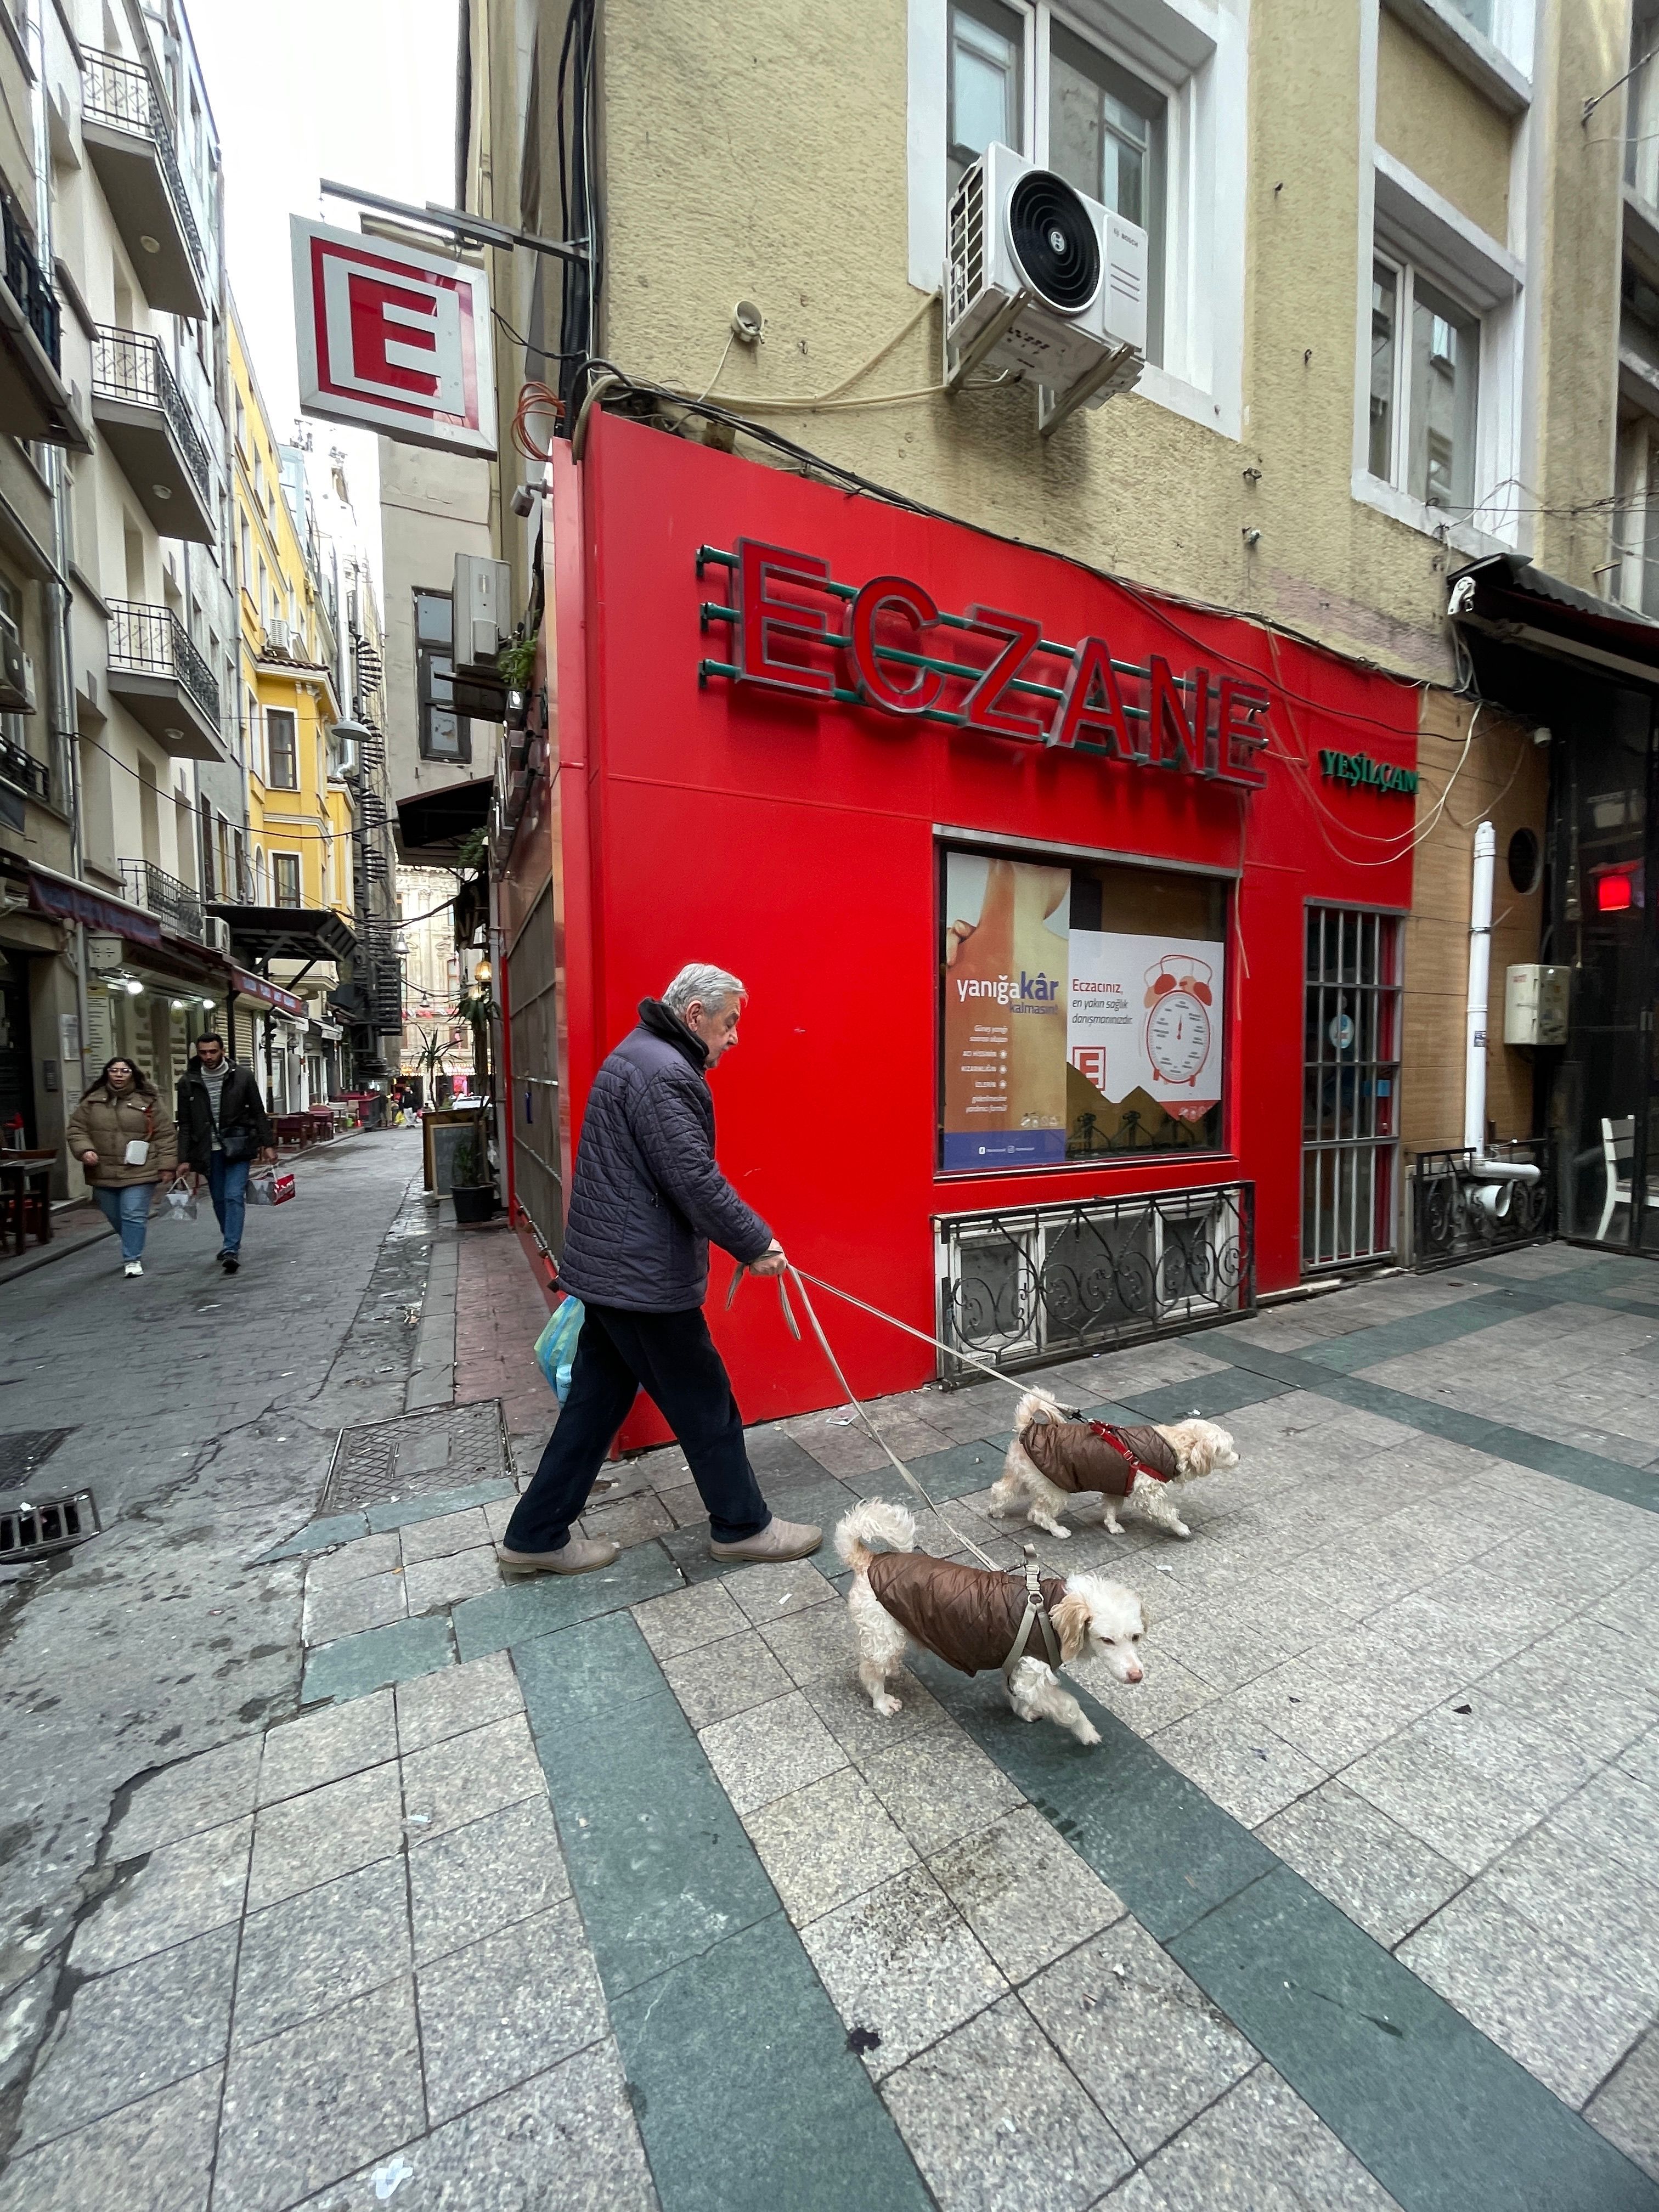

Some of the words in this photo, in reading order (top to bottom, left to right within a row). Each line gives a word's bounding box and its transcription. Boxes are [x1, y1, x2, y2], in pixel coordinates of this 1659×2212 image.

[348, 272, 441, 399] E
[733, 536, 1270, 790] ECZANE
[1318, 749, 1420, 793] YEŞİLÇAM
[1084, 997, 1105, 1010] yakın
